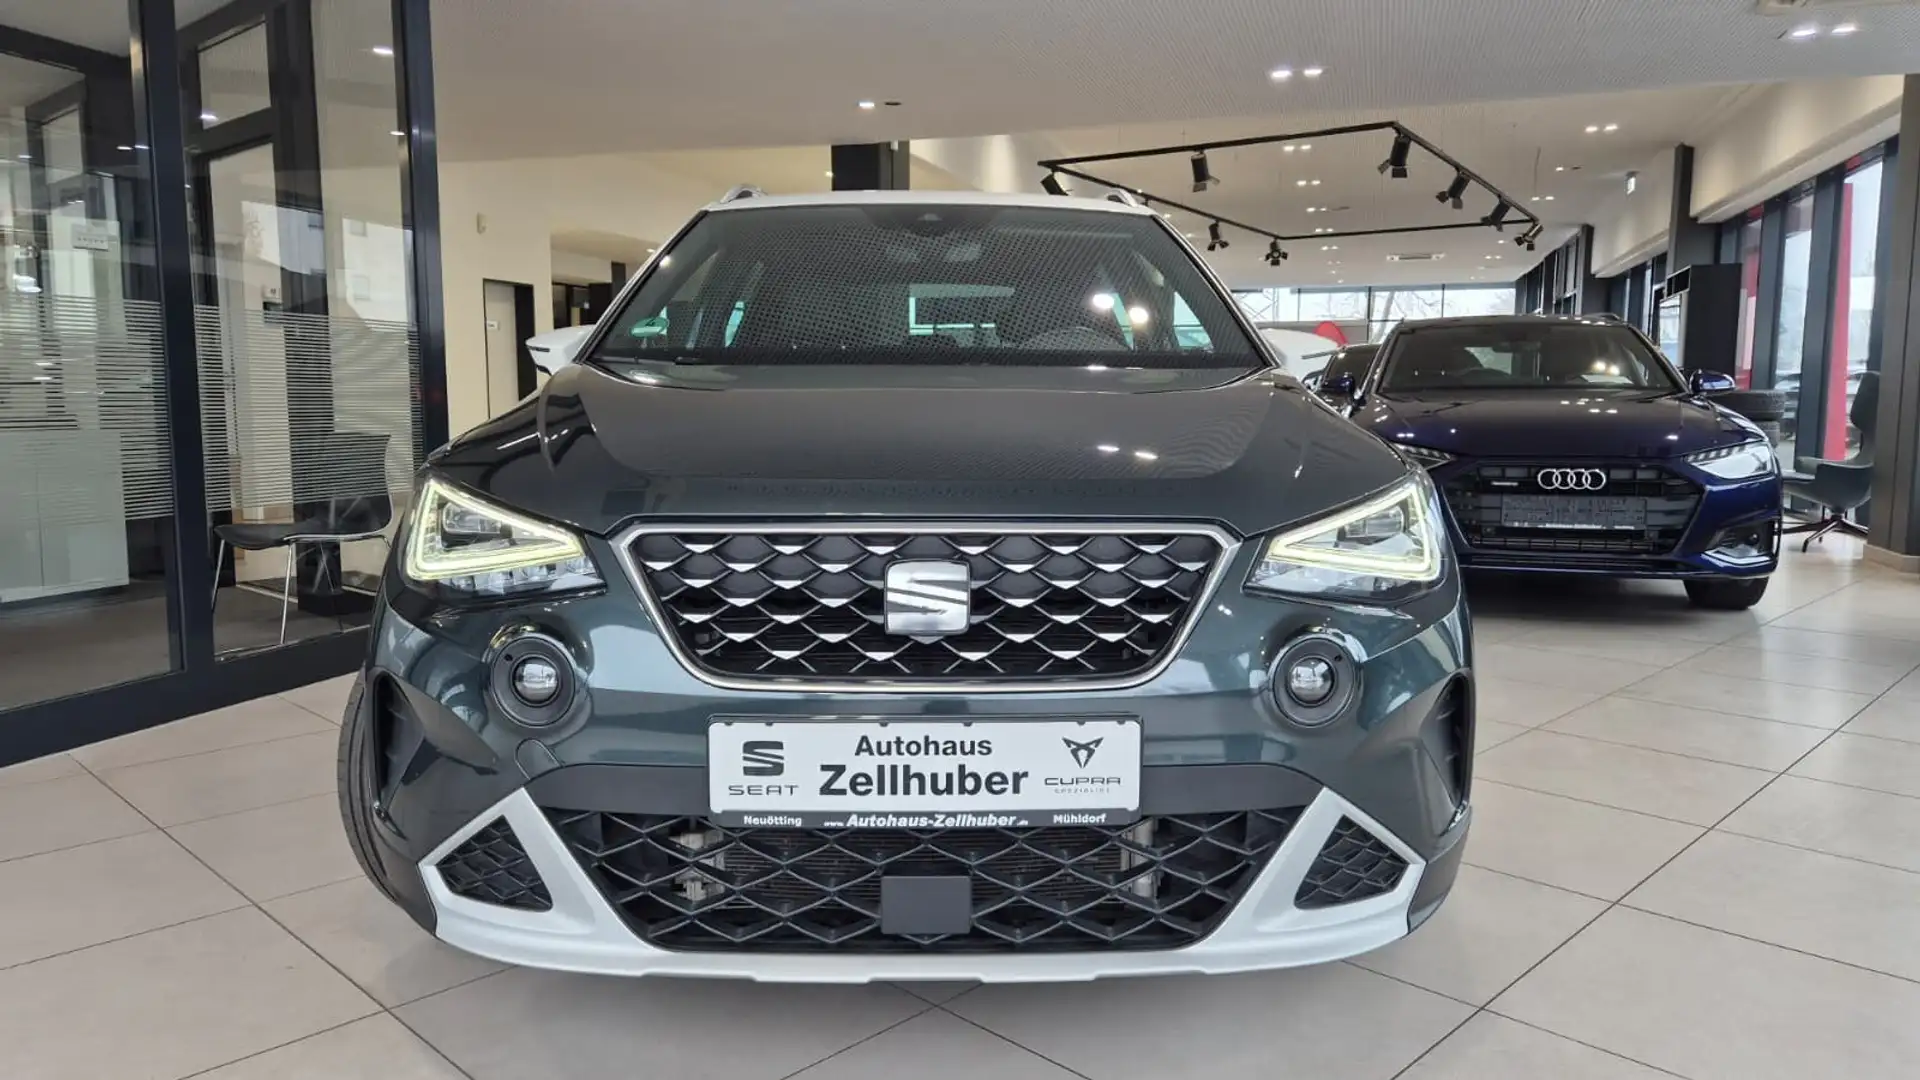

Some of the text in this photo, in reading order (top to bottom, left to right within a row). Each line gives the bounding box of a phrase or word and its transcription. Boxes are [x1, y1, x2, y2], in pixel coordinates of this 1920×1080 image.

[854, 735, 992, 756] Autohaus
[819, 763, 1029, 796] Zellhuber
[1044, 777, 1121, 786] CUPRA
[728, 785, 799, 796] SEAT
[743, 815, 802, 827] Neuötting
[1053, 813, 1107, 825] Mühldorf
